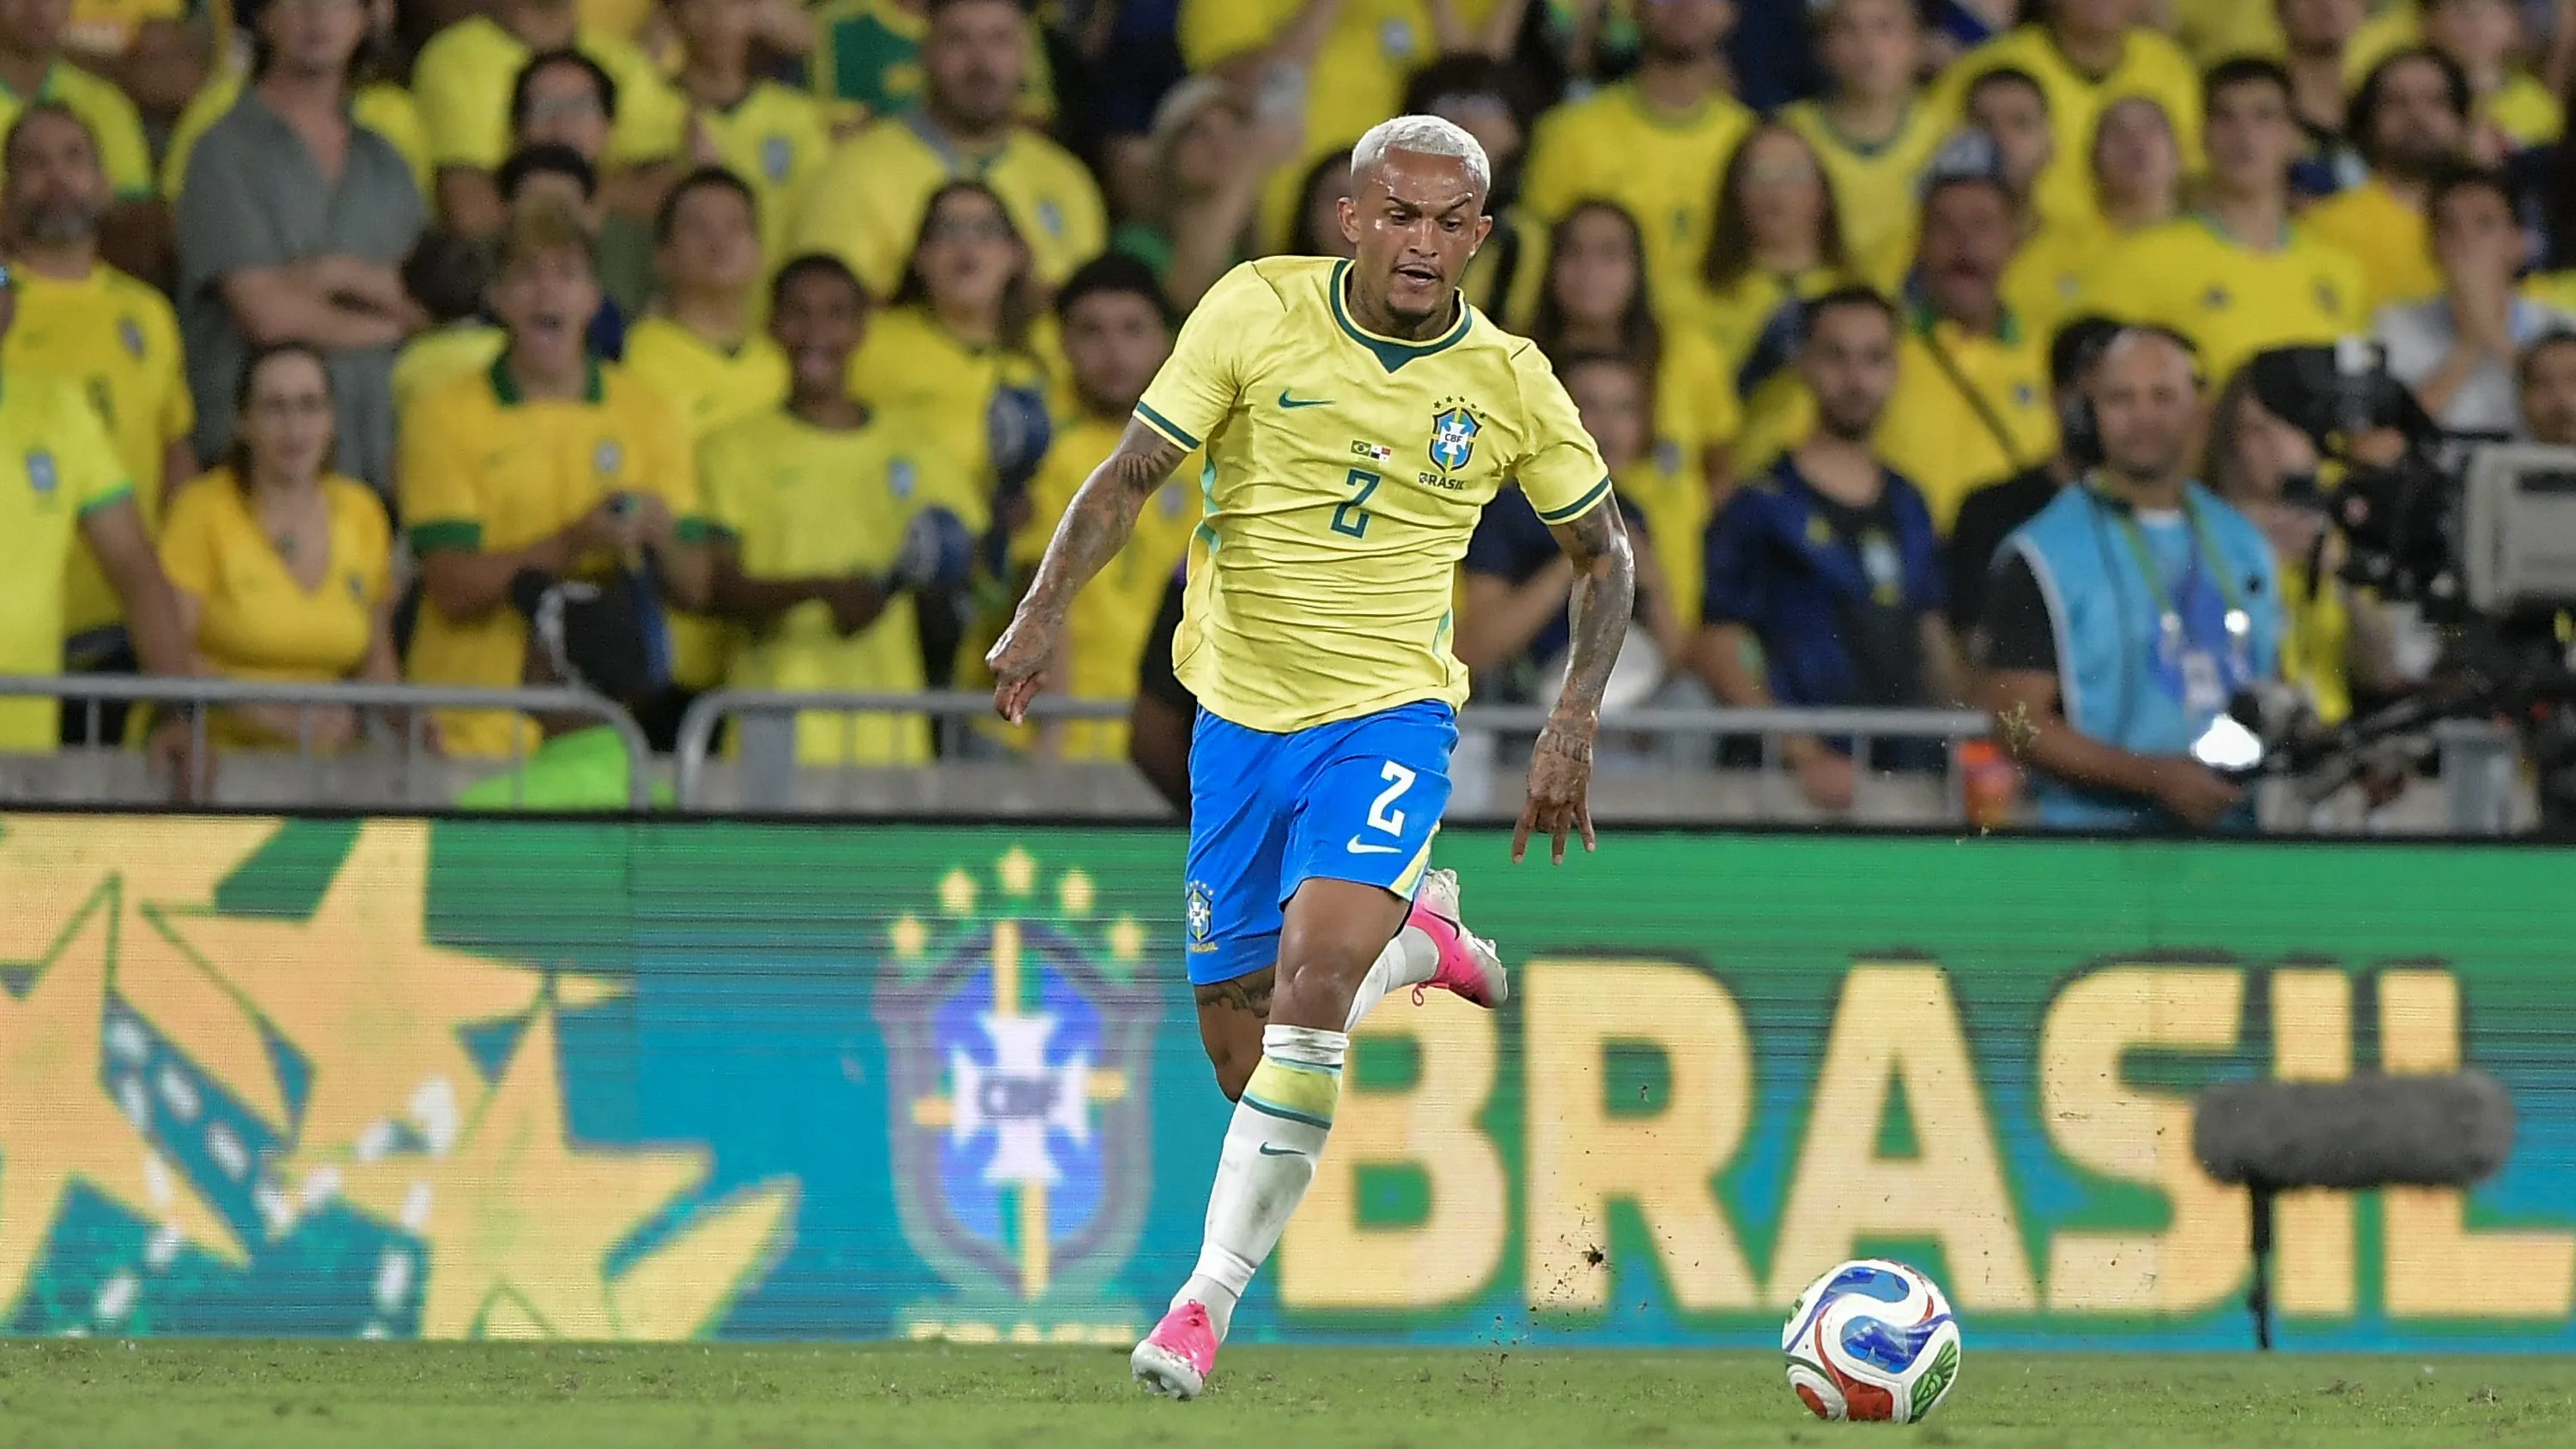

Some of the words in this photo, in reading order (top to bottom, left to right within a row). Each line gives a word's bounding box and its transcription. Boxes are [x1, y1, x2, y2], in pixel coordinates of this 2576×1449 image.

[1444, 433, 1463, 443] CBF
[1330, 468, 1381, 539] 2
[1419, 472, 1464, 490] BRASIL
[1367, 759, 1417, 837] 2
[1278, 958, 2574, 1318] BRASIL
